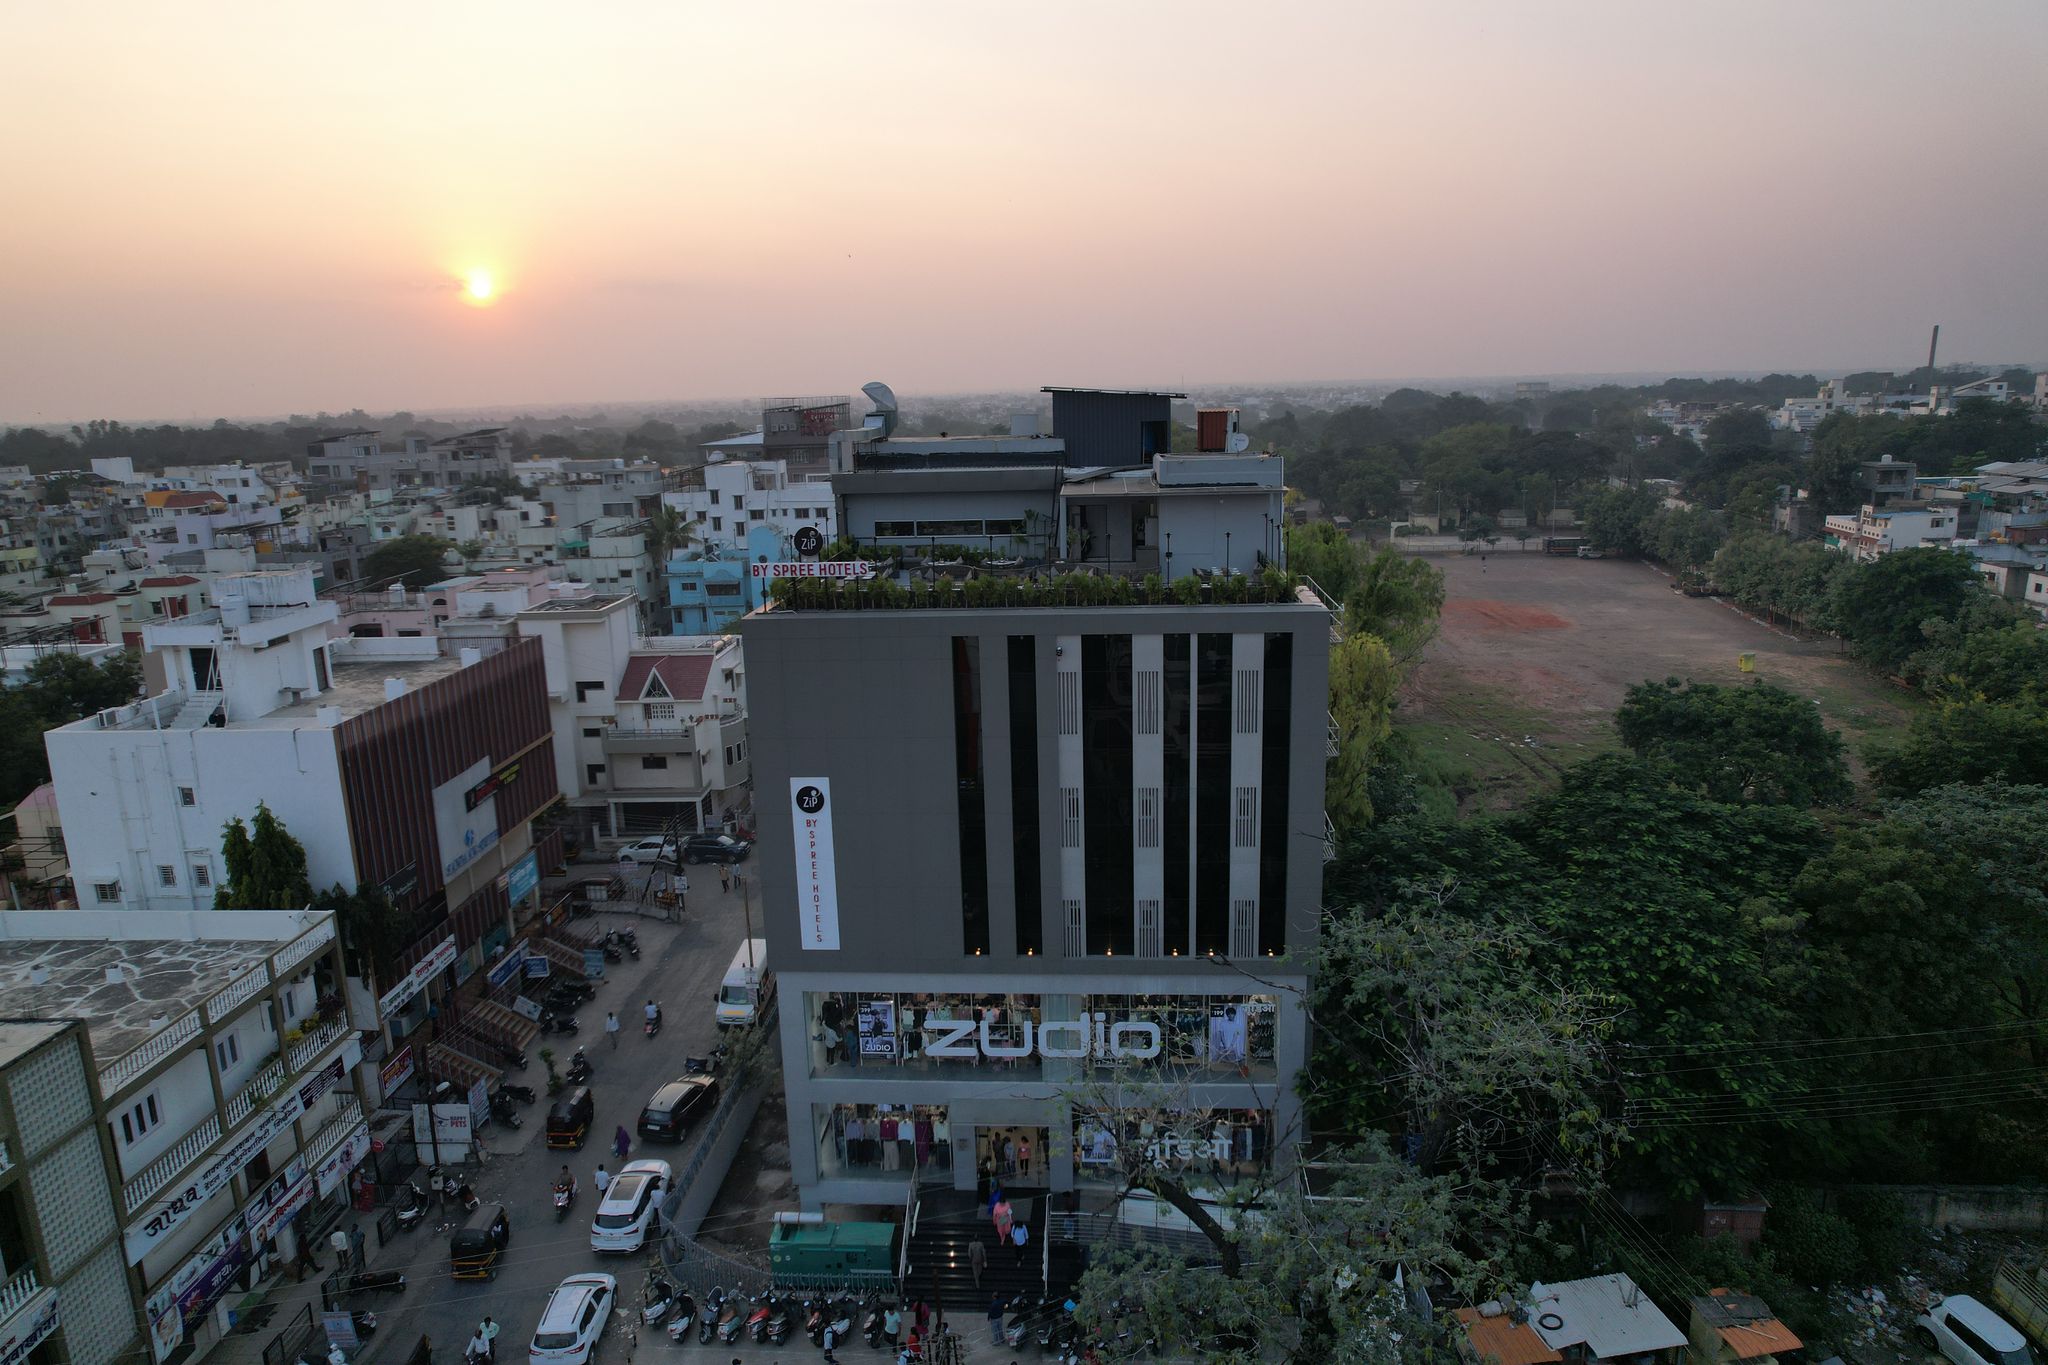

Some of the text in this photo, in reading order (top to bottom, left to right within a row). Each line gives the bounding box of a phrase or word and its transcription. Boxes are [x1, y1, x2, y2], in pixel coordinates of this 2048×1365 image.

[752, 562, 868, 577] BY SPREE HOTELS
[806, 819, 823, 943] BY SPREE HOTELS
[865, 1043, 892, 1052] ZUDIO
[450, 1120, 468, 1128] PETS
